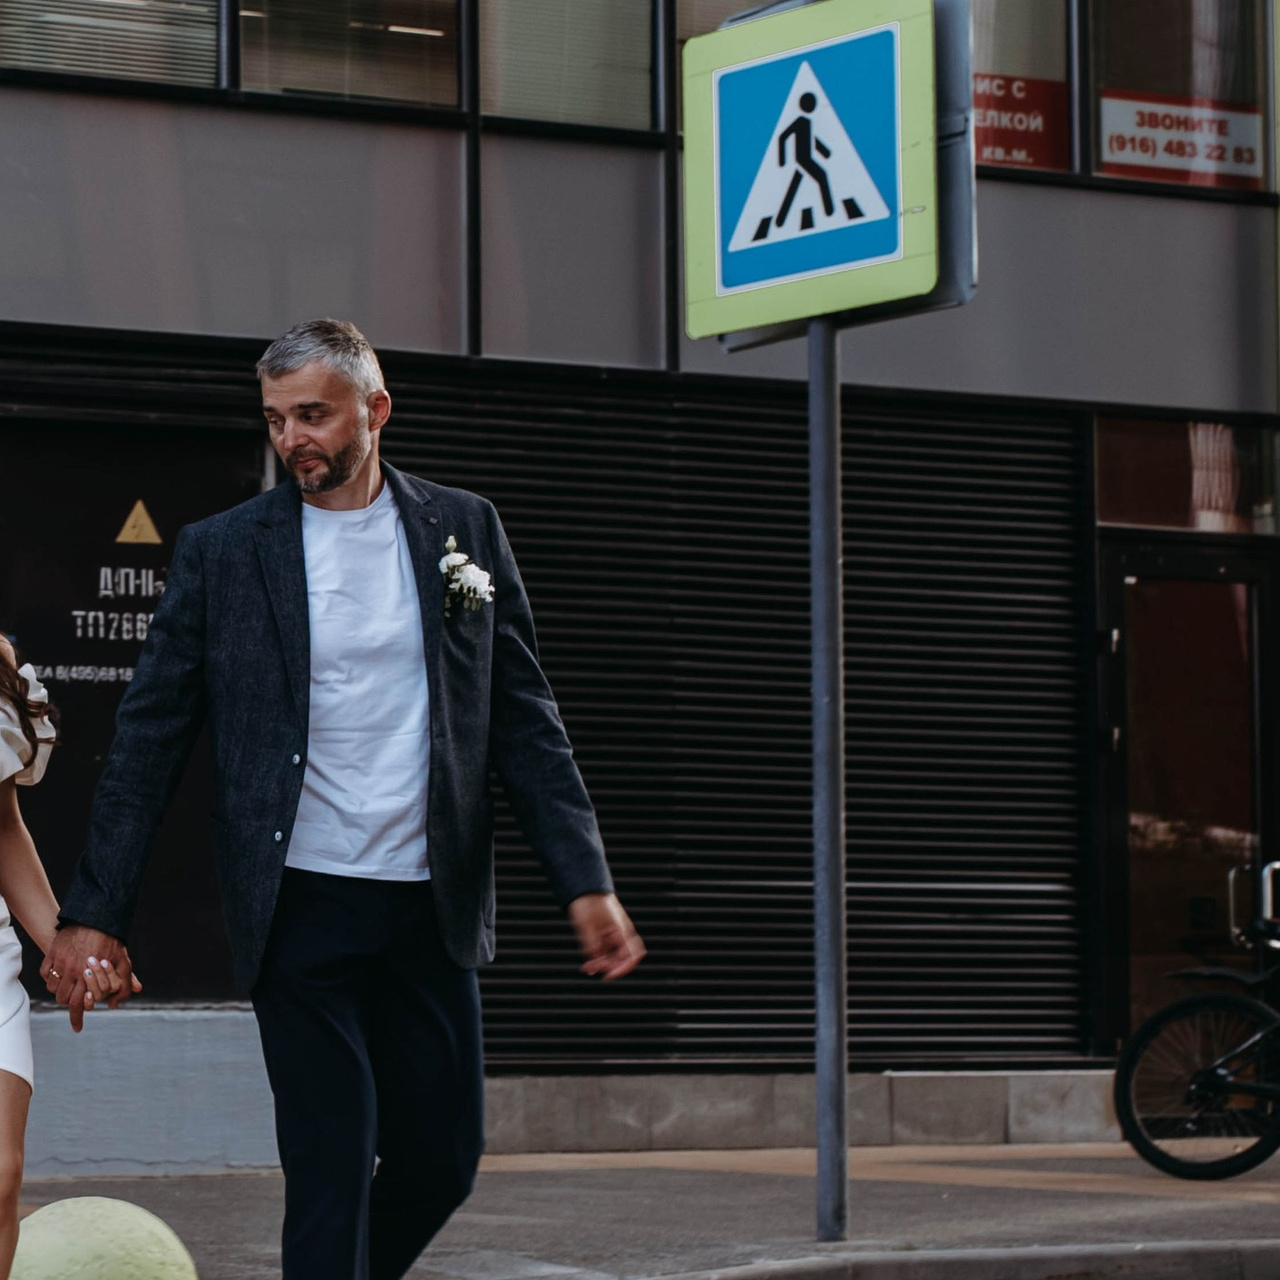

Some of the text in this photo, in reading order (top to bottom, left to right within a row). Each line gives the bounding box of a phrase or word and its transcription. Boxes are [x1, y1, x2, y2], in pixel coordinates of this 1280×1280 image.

[974, 77, 1005, 96] ИС
[974, 108, 1043, 133] ЕЛКОЙ
[1135, 110, 1229, 136] ЗВОНИТЕ
[1108, 134, 1157, 159] (916)
[1163, 139, 1197, 158] 483
